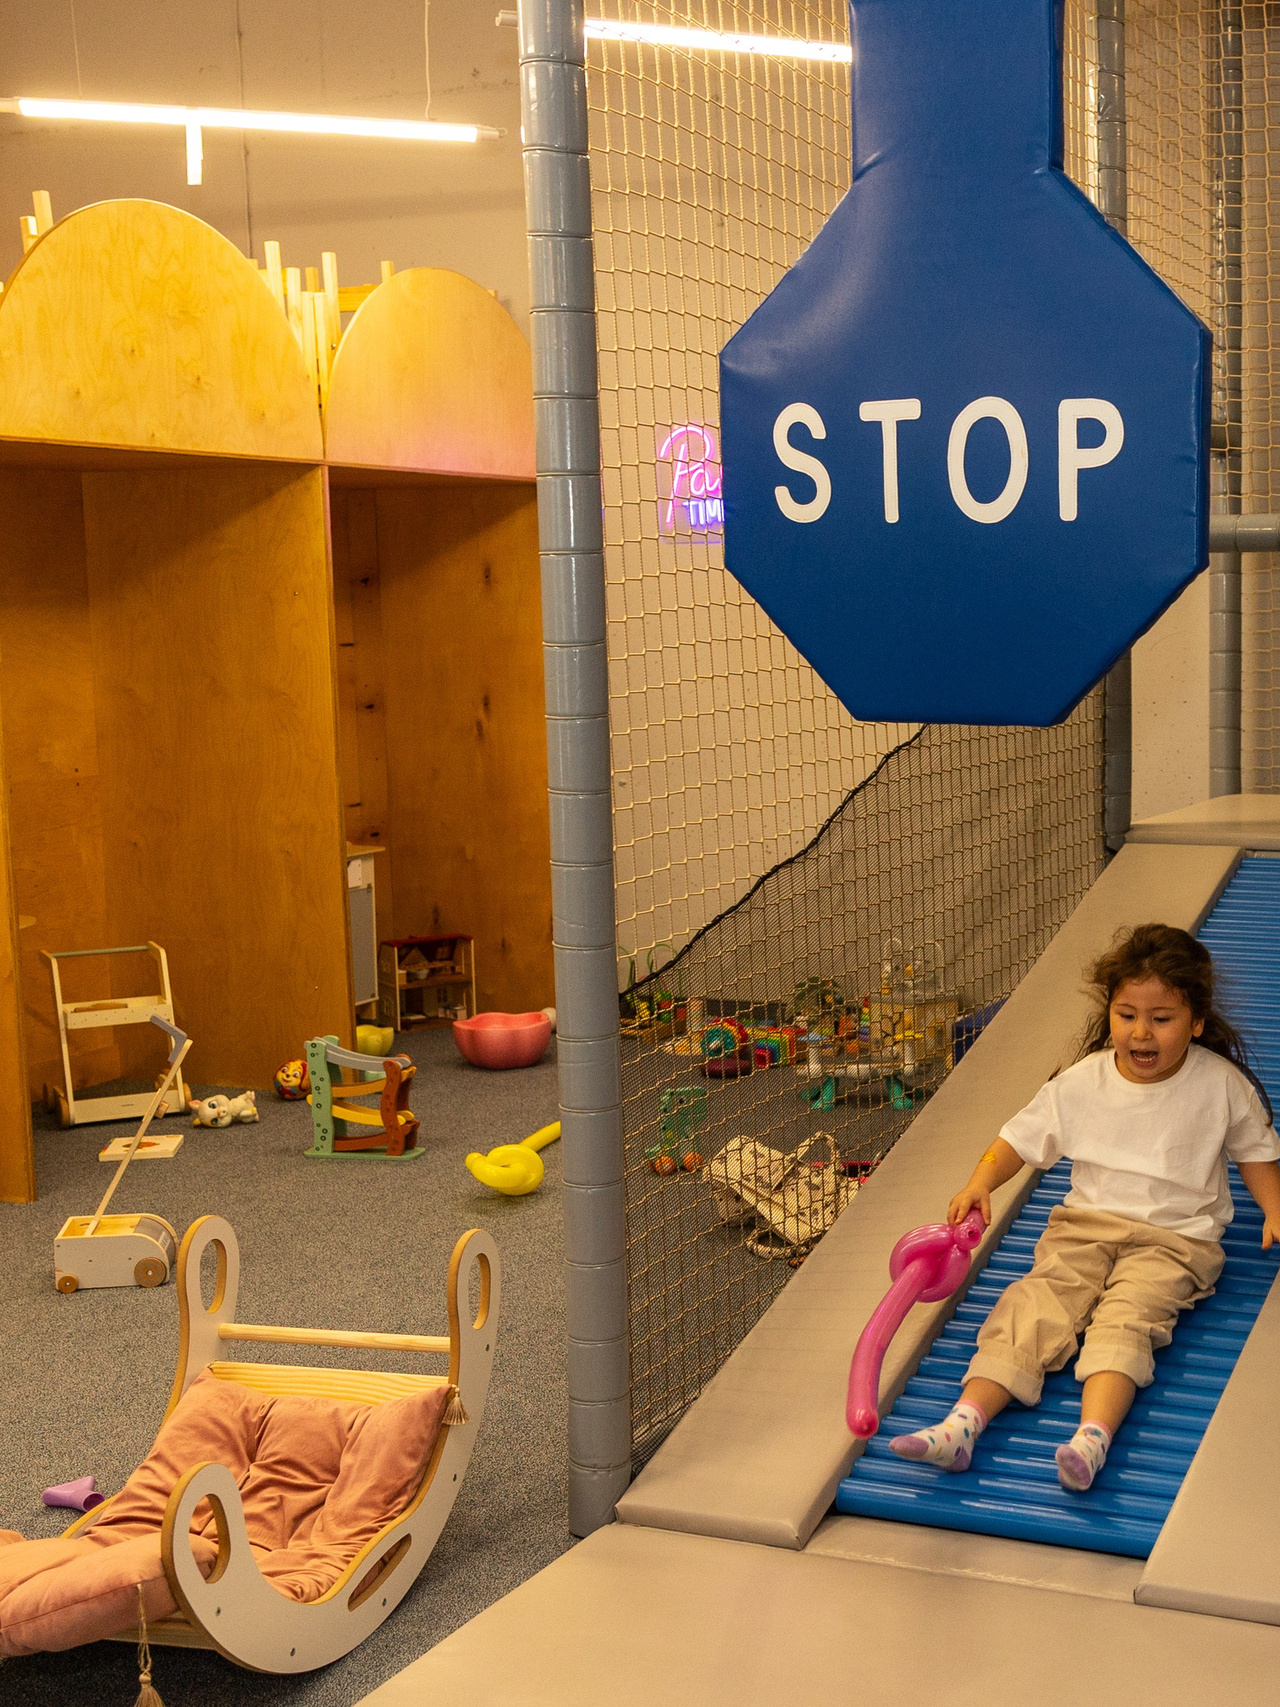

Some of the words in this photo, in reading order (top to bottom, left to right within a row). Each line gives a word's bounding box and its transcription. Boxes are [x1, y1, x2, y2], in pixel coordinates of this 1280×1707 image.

[660, 426, 723, 523] Pa
[772, 396, 1125, 524] STOP
[682, 498, 725, 526] TIM
